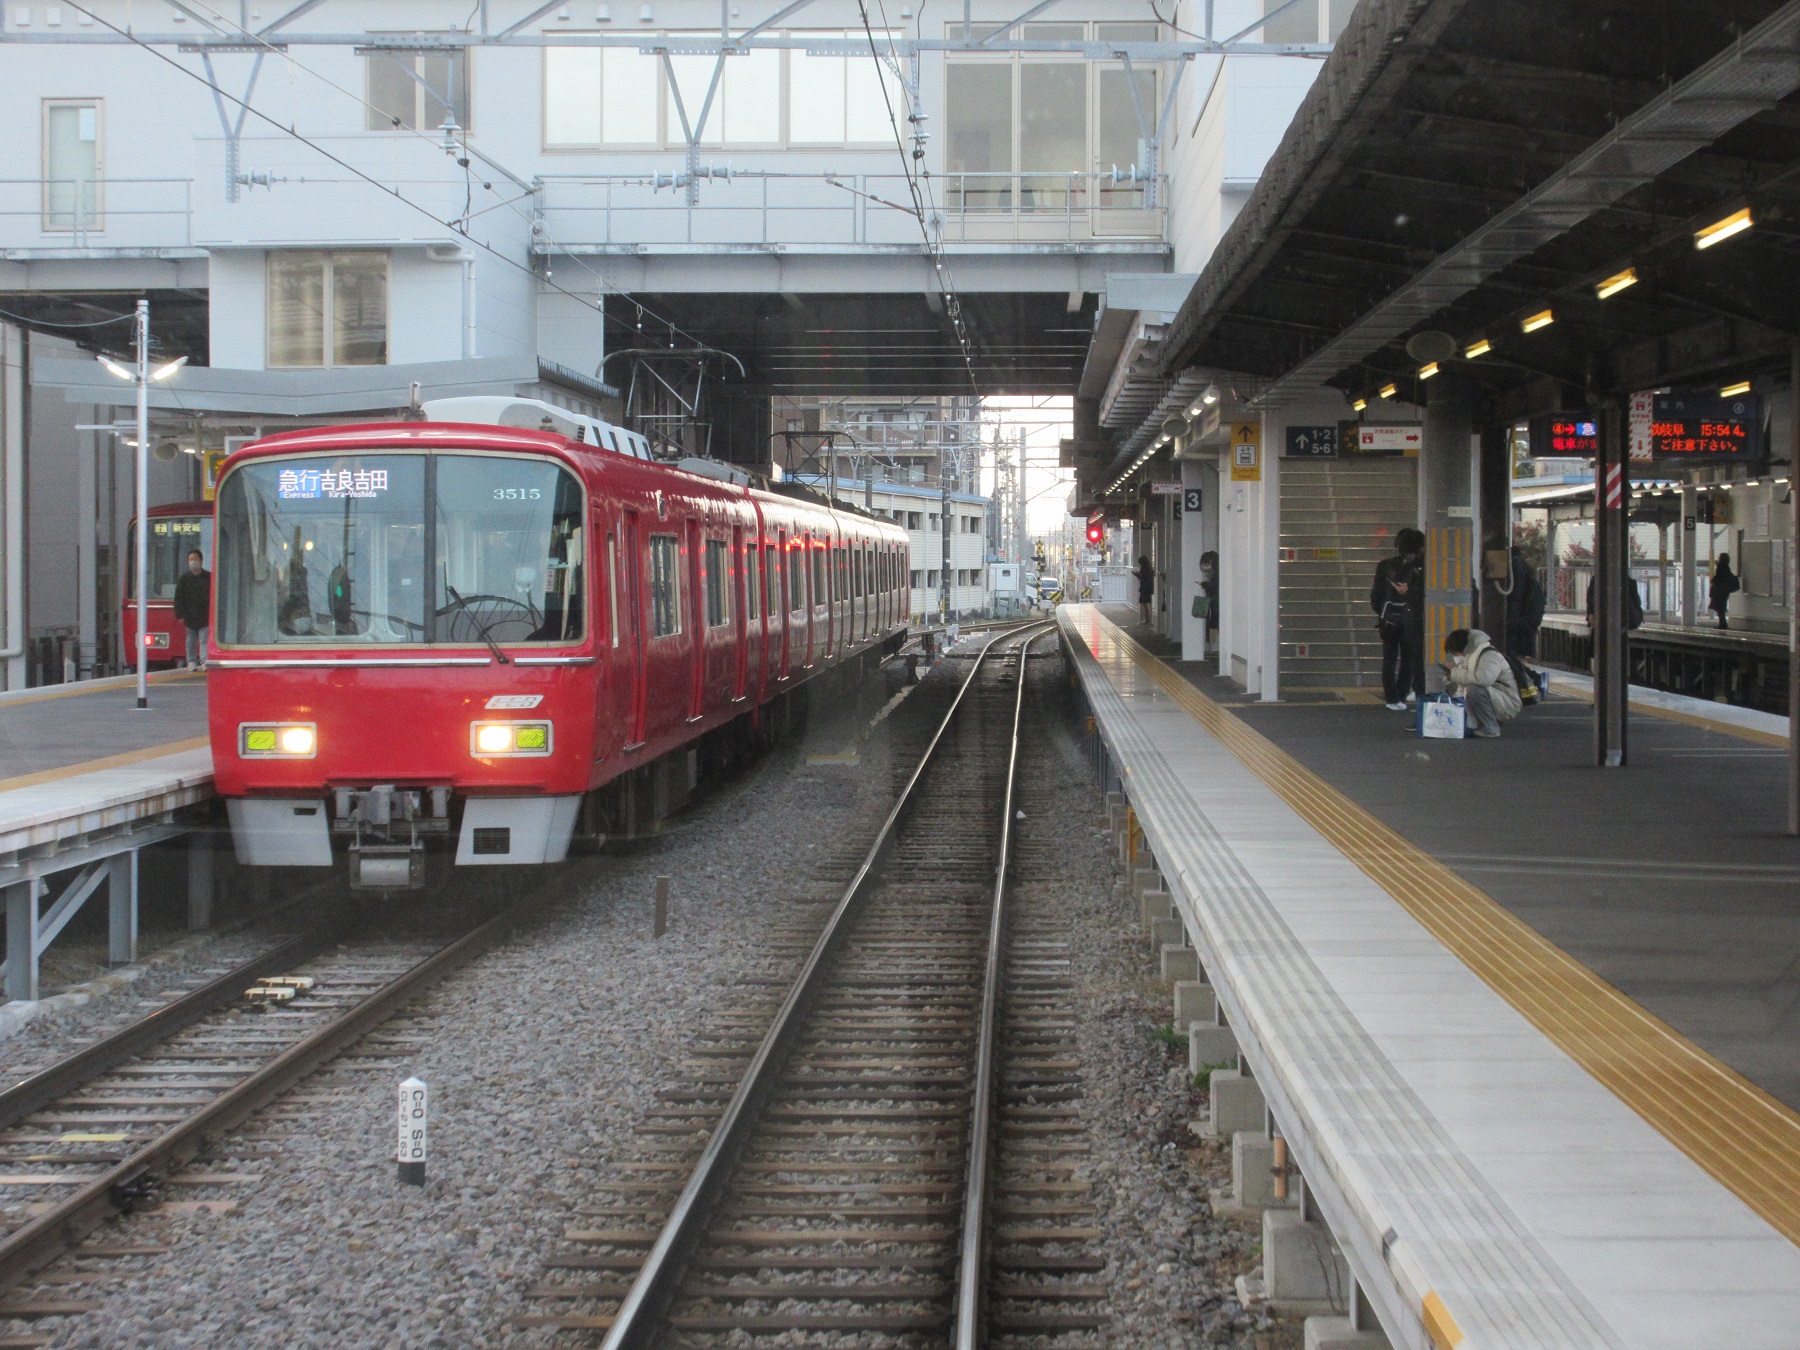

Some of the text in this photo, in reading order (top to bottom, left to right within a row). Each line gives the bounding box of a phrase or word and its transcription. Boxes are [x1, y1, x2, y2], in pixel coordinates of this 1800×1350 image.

[1701, 424, 1730, 437] 15:54
[1661, 438, 1738, 452] ご注意下さい。
[279, 469, 388, 491] 急行 吉良吉田
[283, 490, 377, 499] Express Kira-Yoshida
[493, 488, 541, 500] 3515
[1187, 492, 1200, 509] 3
[1685, 518, 1694, 529] 5
